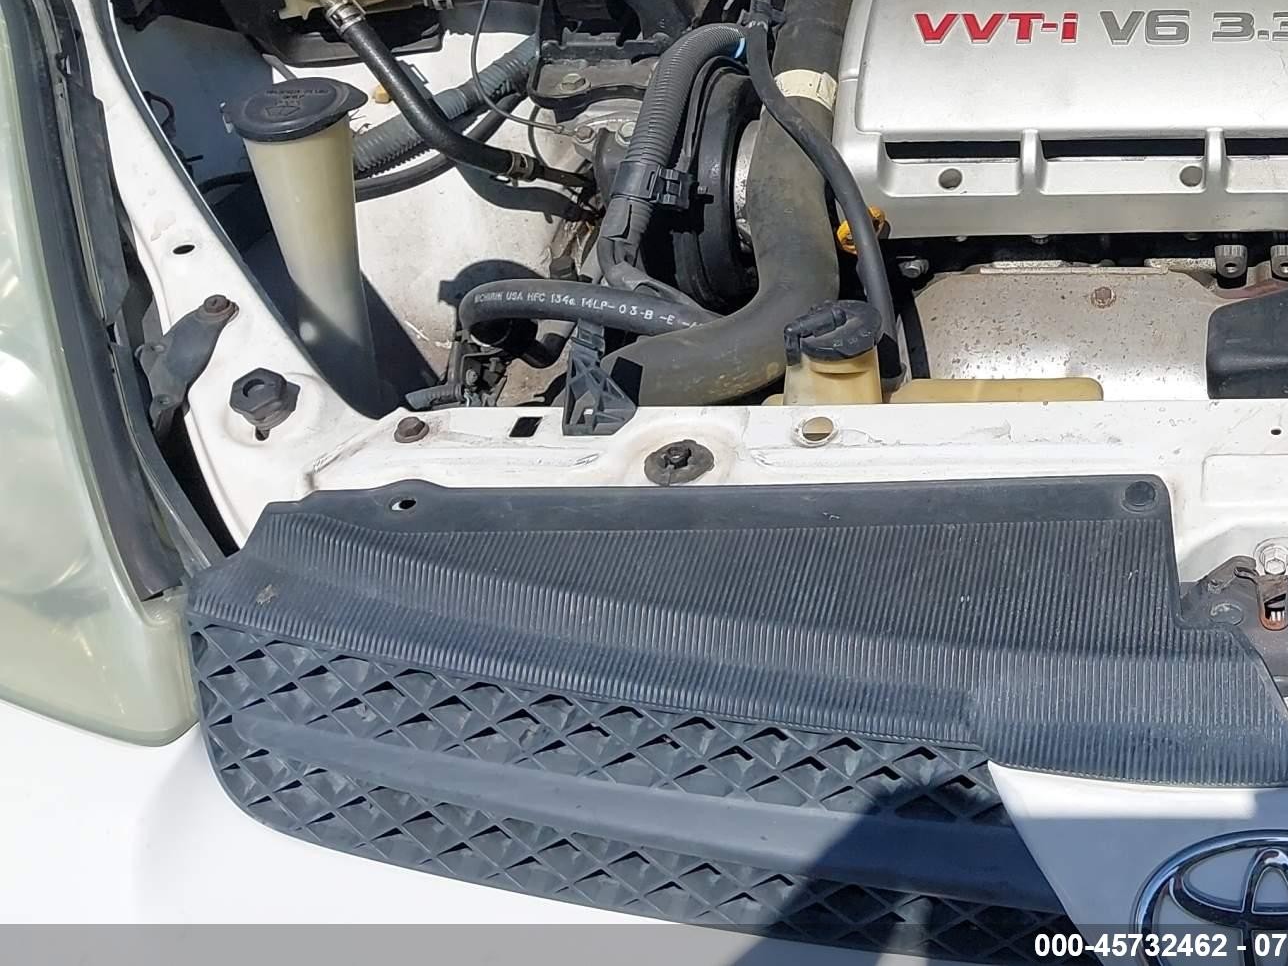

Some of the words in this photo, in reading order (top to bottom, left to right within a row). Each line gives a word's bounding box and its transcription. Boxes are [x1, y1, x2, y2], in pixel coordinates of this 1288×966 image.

[913, 12, 1079, 44] VVT-i
[1100, 10, 1191, 44] V6
[506, 291, 523, 301] USA
[527, 292, 546, 302] HFC
